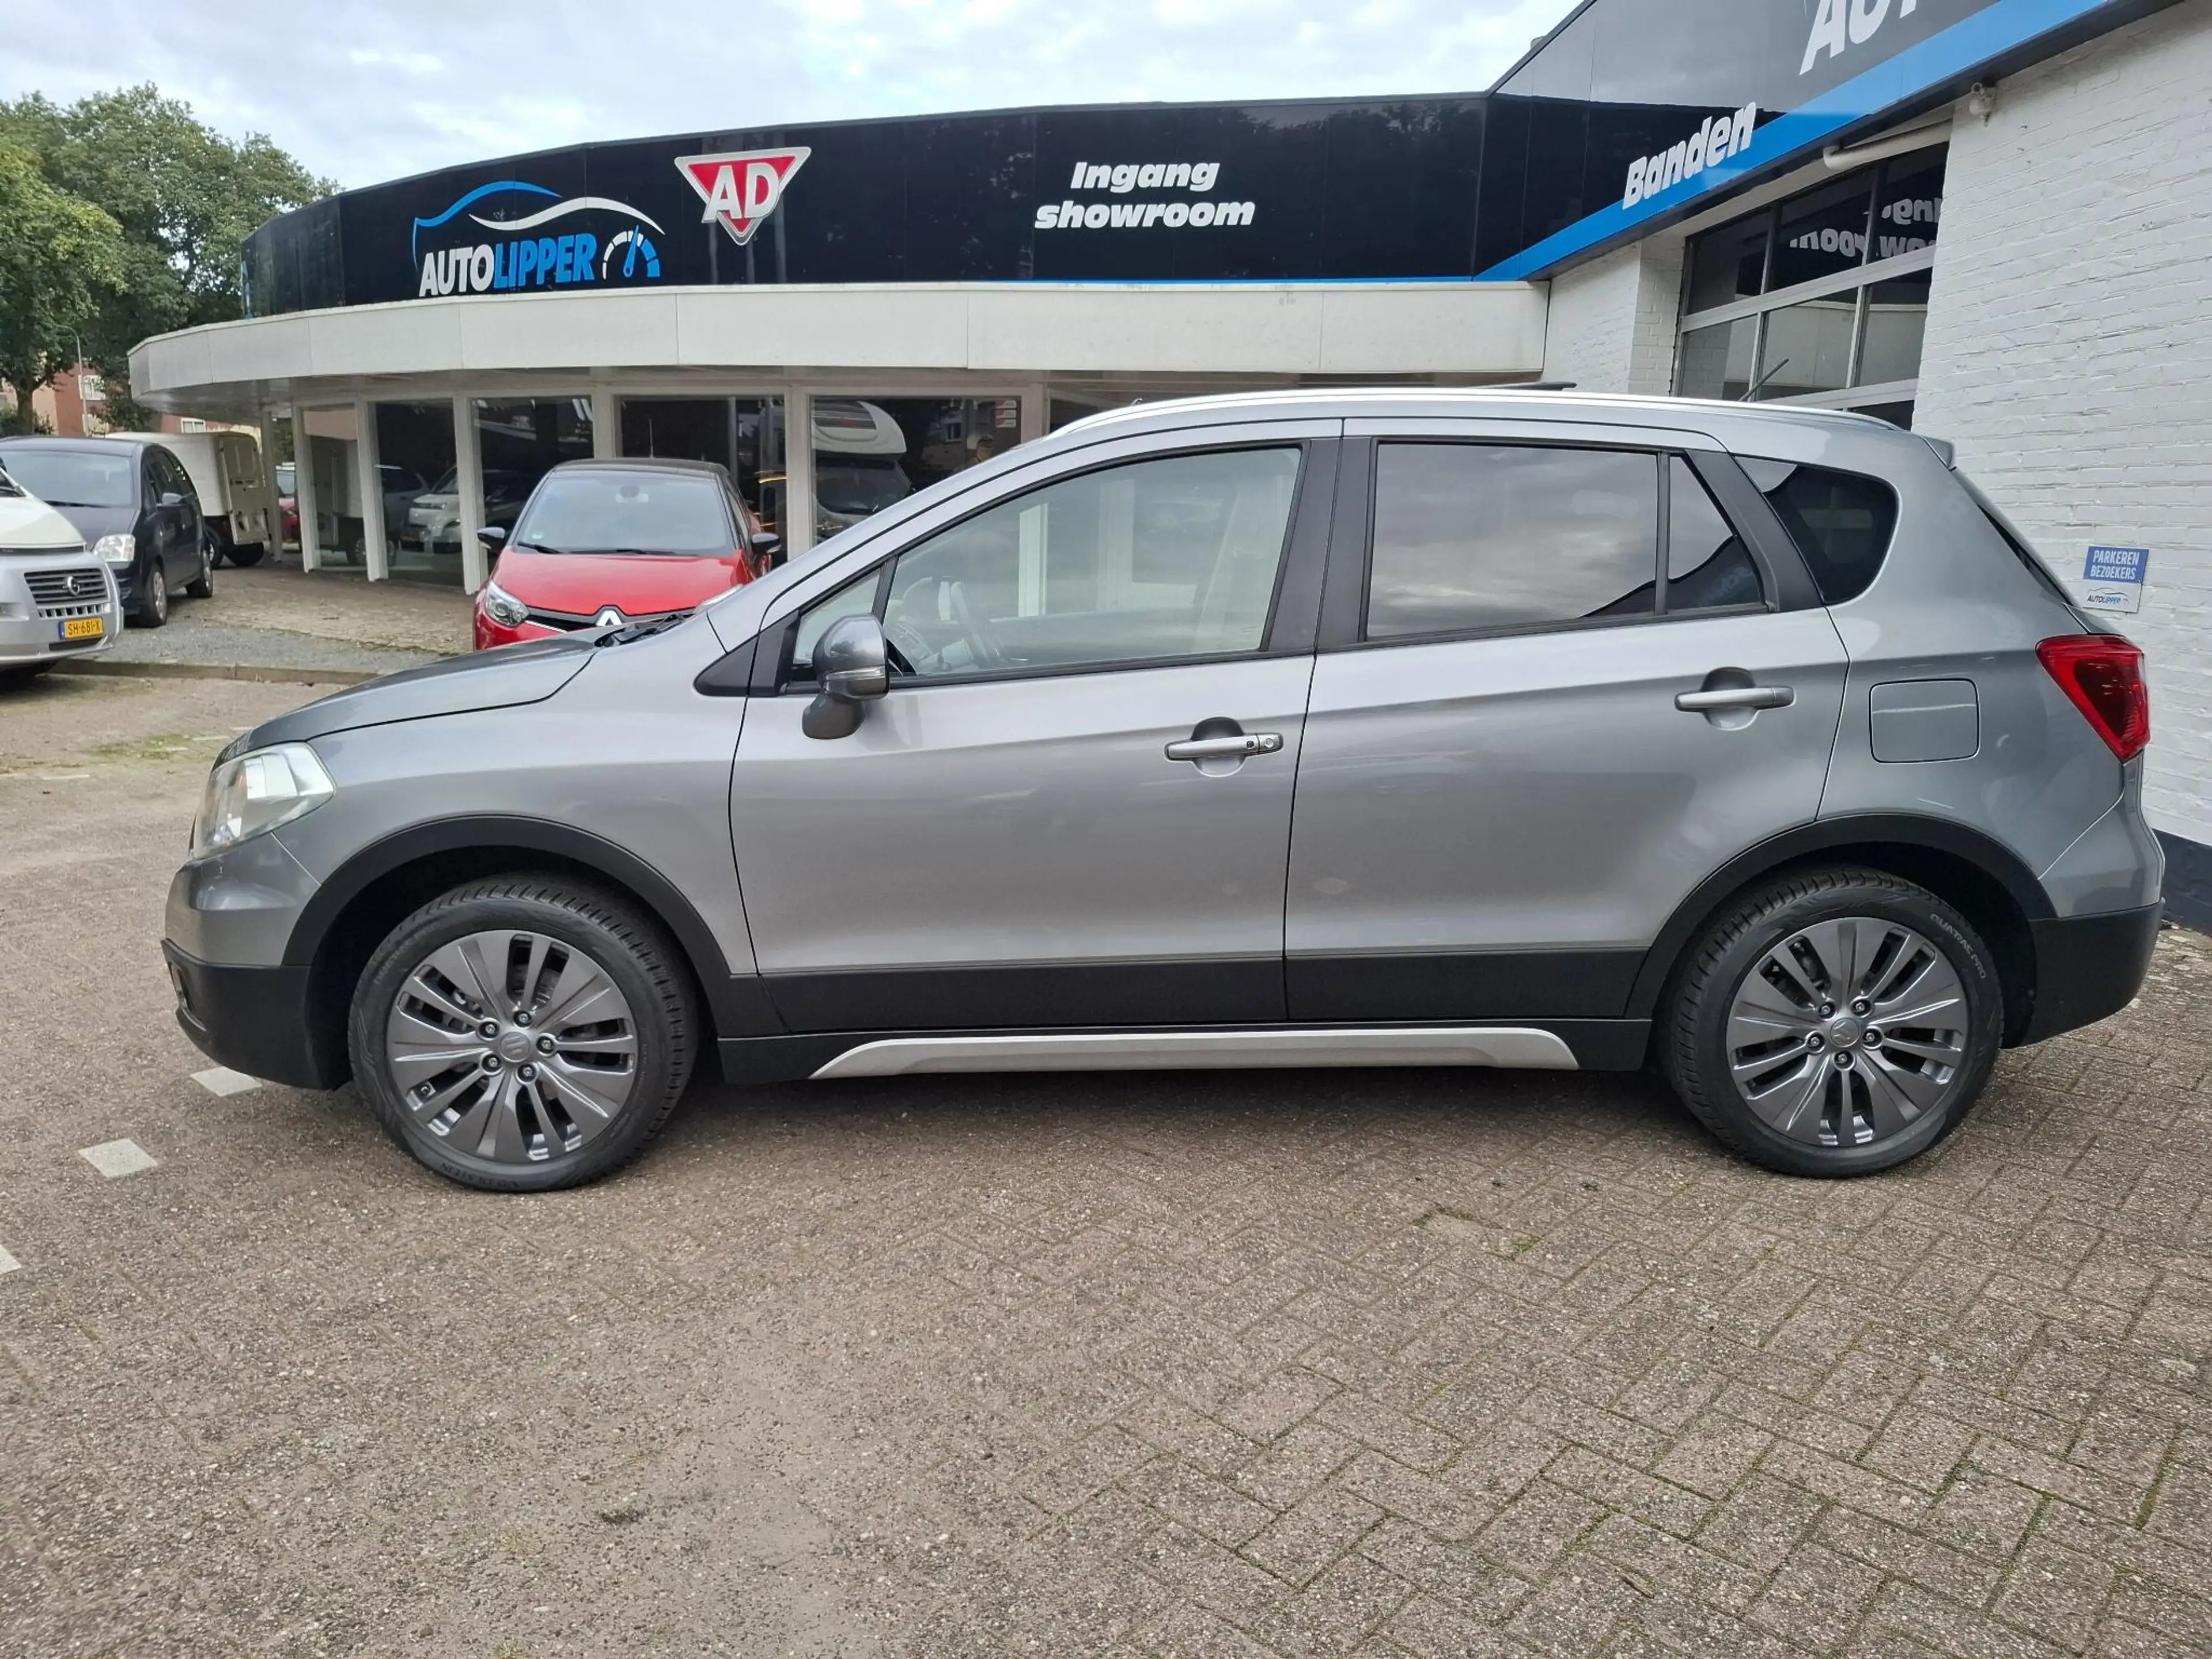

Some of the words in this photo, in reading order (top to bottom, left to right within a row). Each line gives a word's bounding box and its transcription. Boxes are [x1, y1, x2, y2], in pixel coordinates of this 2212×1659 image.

[1622, 101, 1756, 210] Banden
[701, 162, 779, 223] AD
[1070, 161, 1219, 194] Ingang
[1035, 200, 1256, 229] showroom
[419, 233, 597, 297] AUTOLIPPER
[2090, 565, 2137, 579] BEZOEKERS
[2093, 550, 2140, 566] PARKEREN
